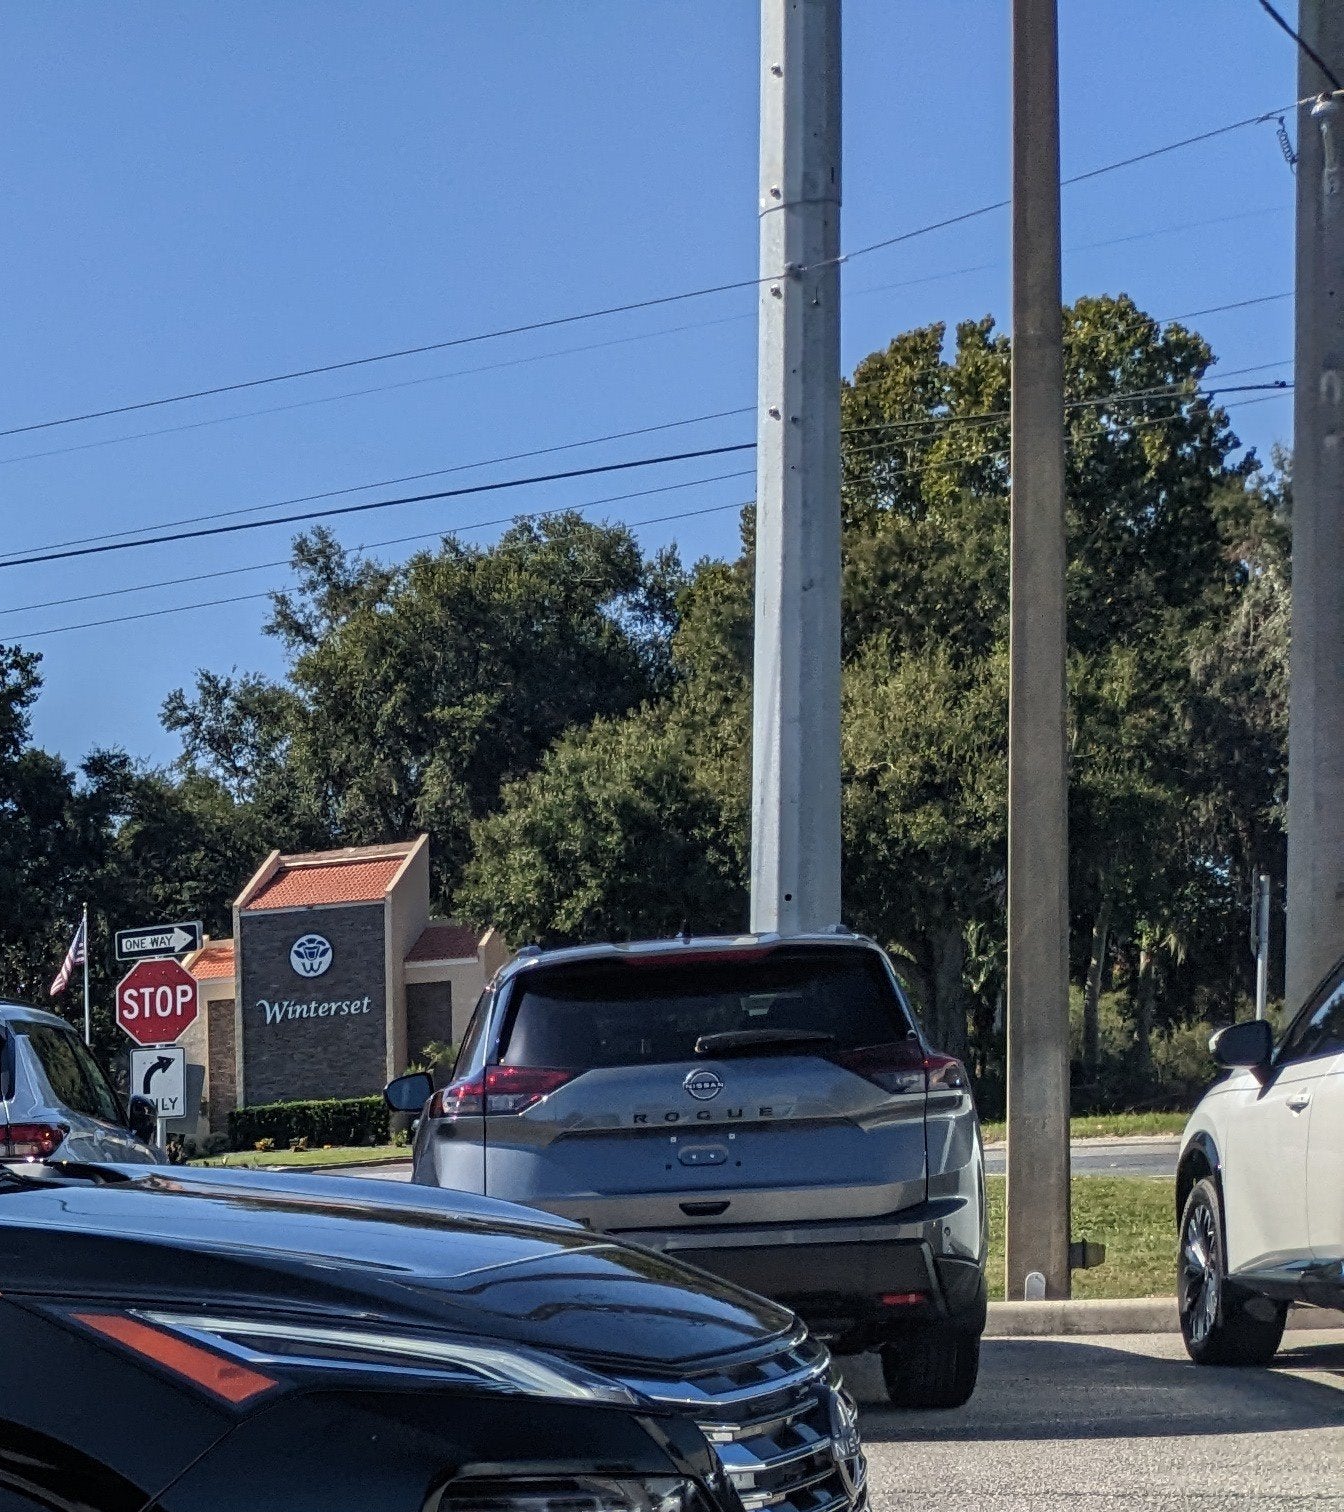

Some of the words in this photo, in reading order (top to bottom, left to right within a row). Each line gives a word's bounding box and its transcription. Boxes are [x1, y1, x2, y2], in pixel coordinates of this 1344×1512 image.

[125, 939, 146, 950] ONE
[149, 935, 174, 947] WAY
[122, 984, 193, 1019] STOP
[256, 996, 371, 1025] Winterset
[685, 1081, 724, 1089] NISSAN
[149, 1096, 178, 1110] NLY
[633, 1107, 773, 1124] ROGUE
